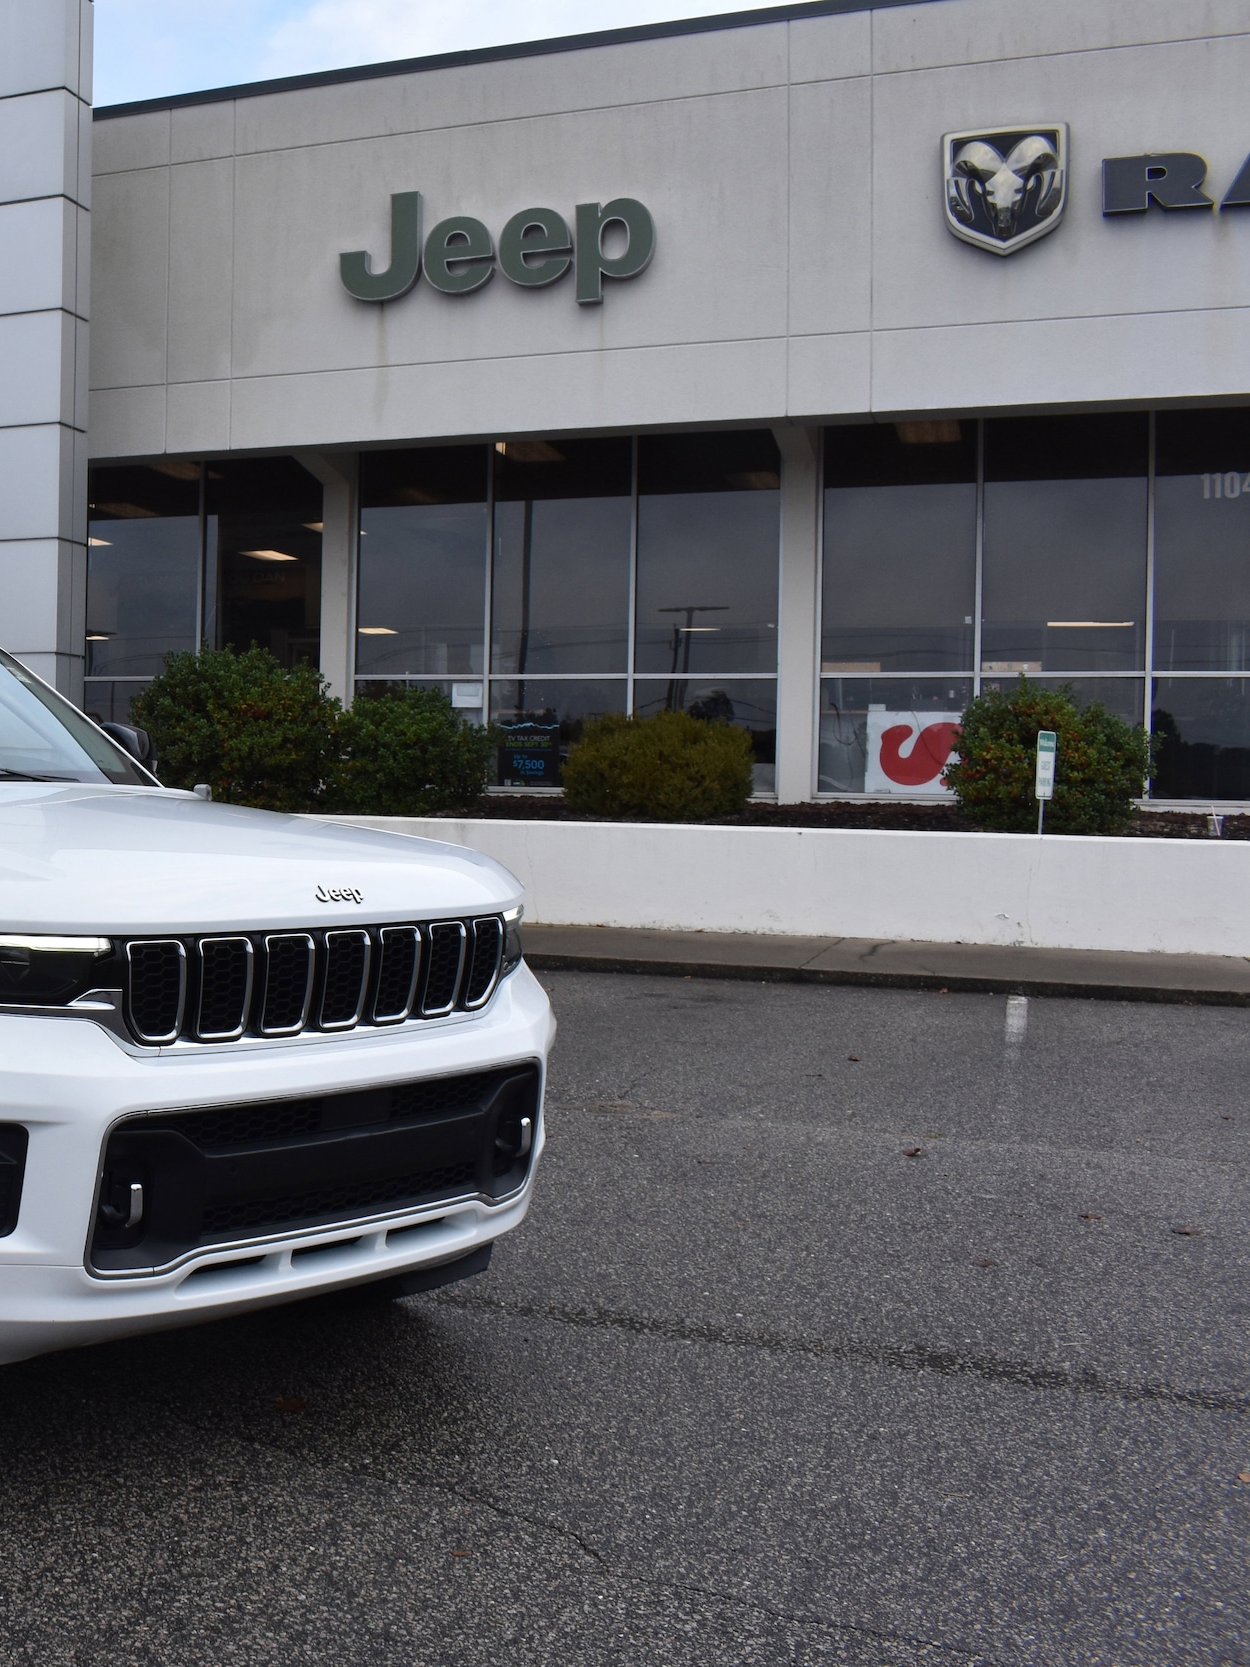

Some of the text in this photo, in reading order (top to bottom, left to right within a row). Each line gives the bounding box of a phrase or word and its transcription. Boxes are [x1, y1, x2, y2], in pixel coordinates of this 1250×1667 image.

[339, 190, 656, 305] Jeep
[512, 760, 545, 770] $7,500
[315, 884, 364, 904] Jeep
